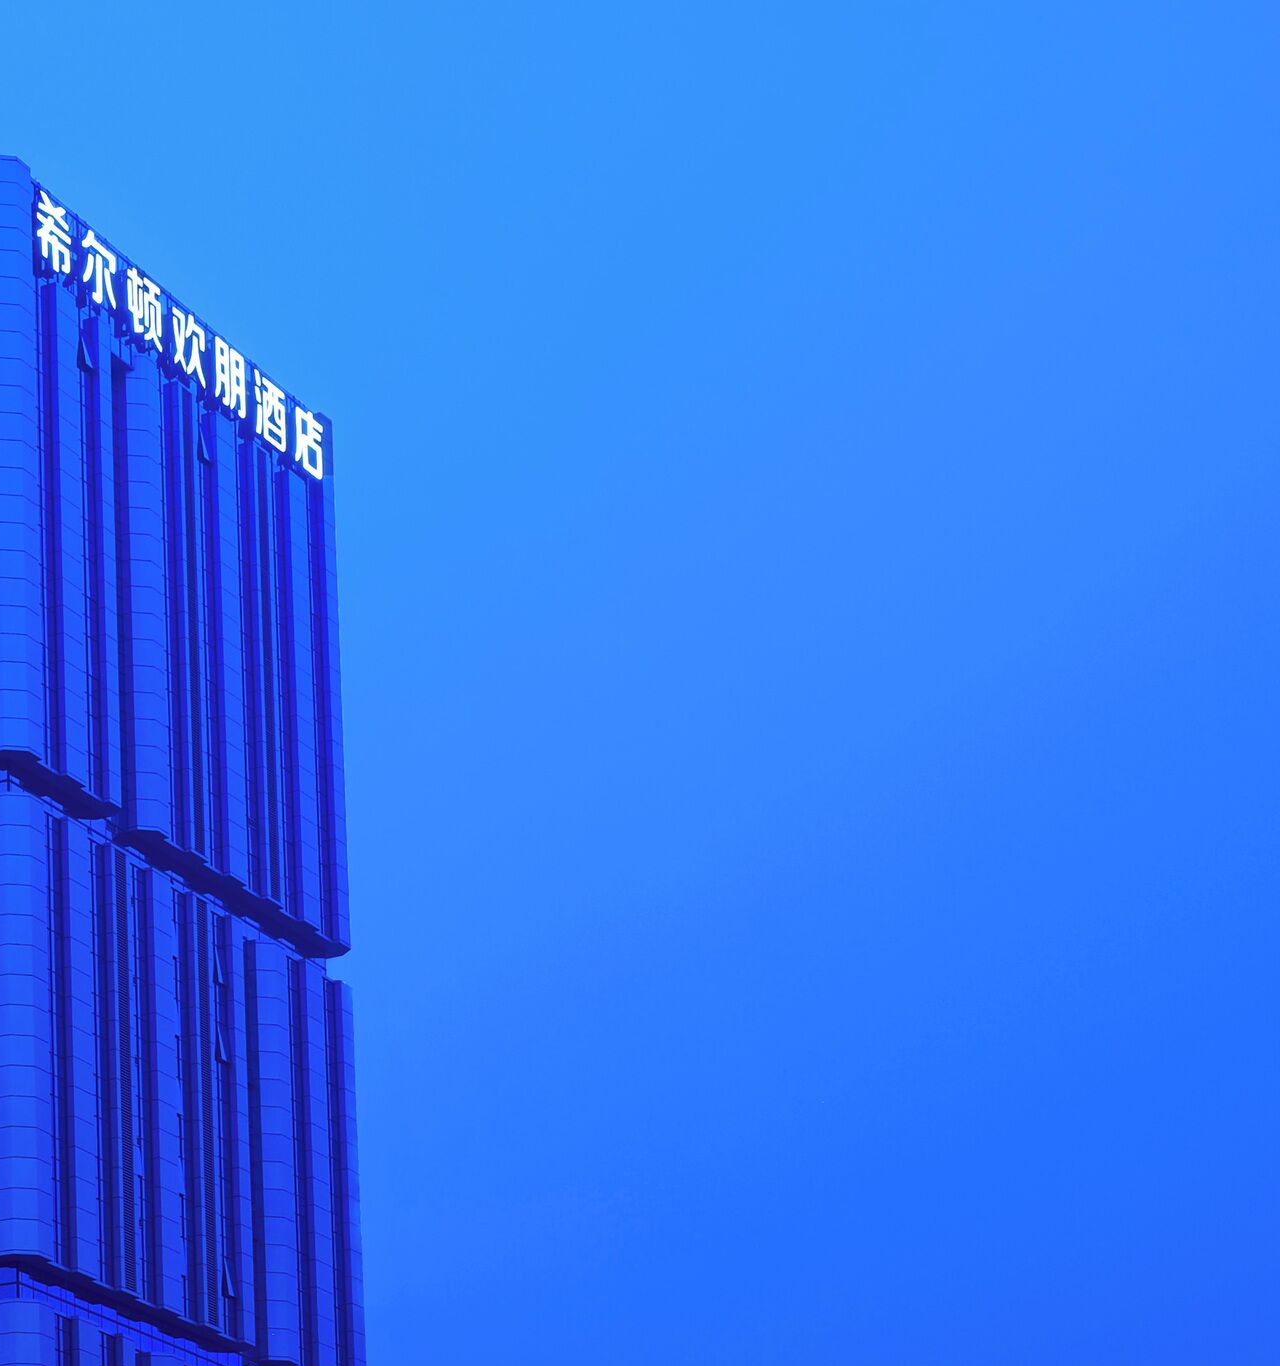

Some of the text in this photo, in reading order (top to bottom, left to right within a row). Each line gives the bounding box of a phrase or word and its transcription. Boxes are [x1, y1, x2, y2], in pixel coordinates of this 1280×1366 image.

[36, 189, 324, 480] 希尔顿欢朋酒店
